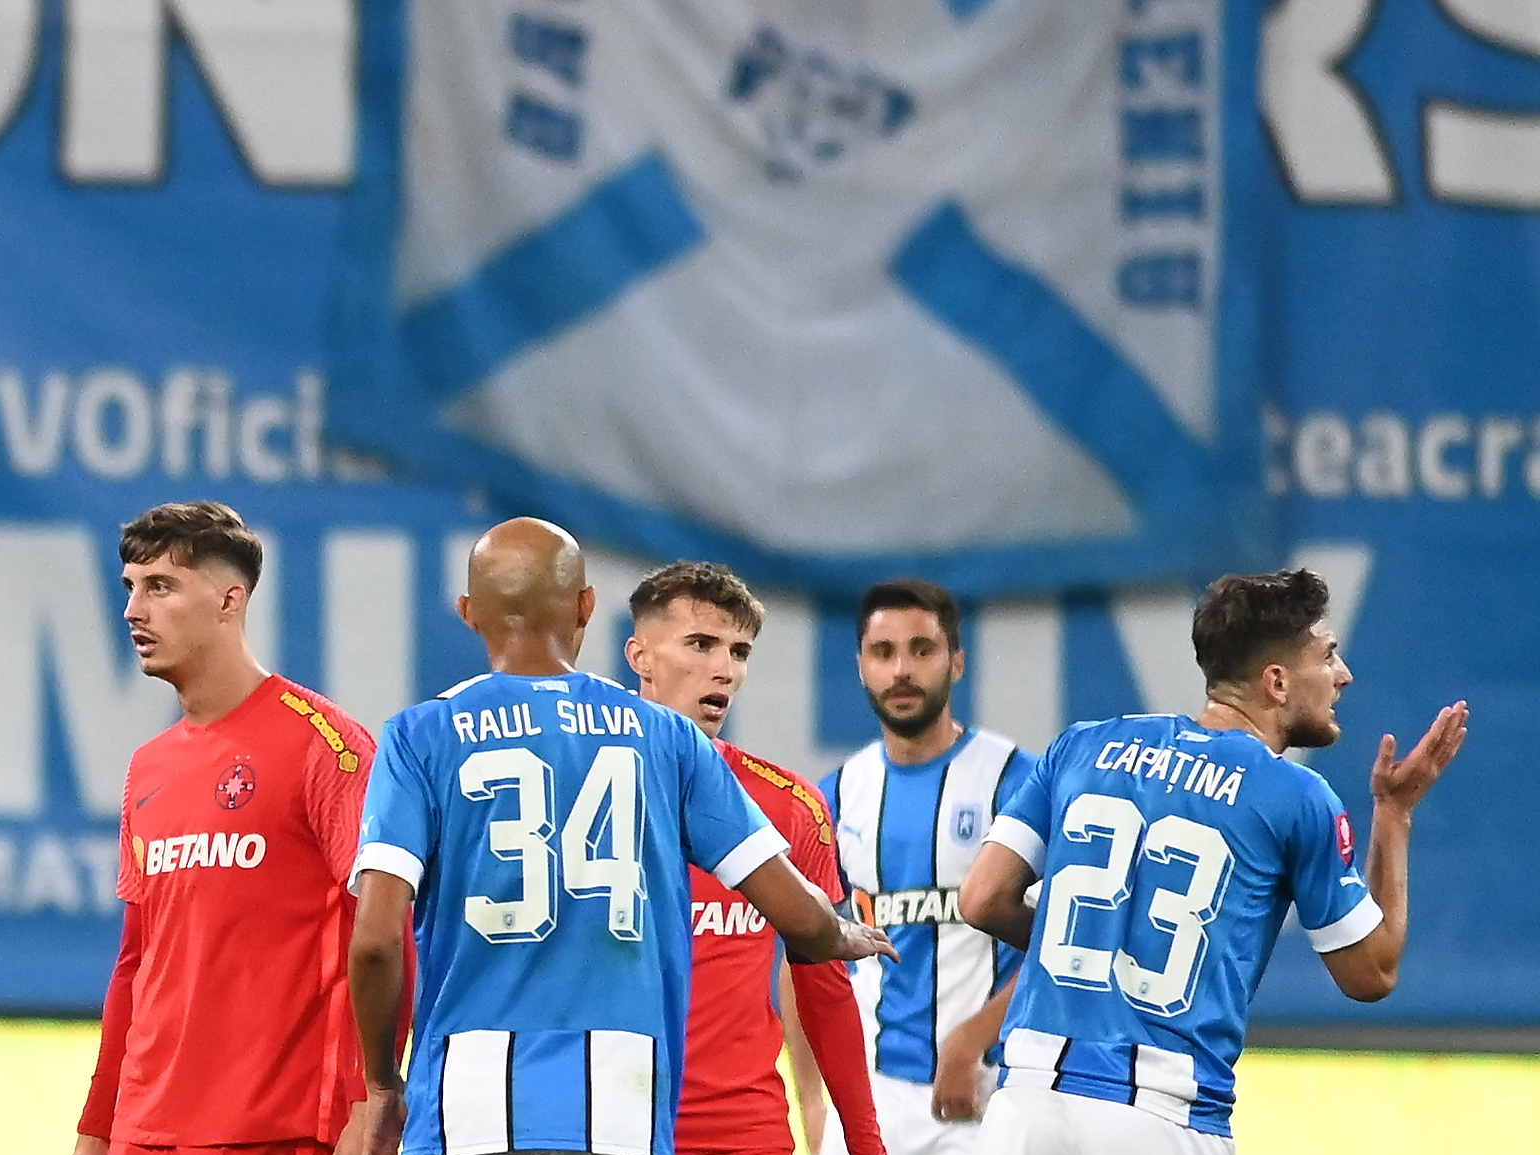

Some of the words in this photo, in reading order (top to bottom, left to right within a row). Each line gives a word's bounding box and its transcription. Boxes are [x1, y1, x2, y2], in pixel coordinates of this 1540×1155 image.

[452, 703, 542, 744] RAUL
[557, 699, 644, 738] SILVA
[146, 832, 267, 876] BETANO
[458, 745, 649, 944] 34
[1039, 792, 1236, 1018] 23
